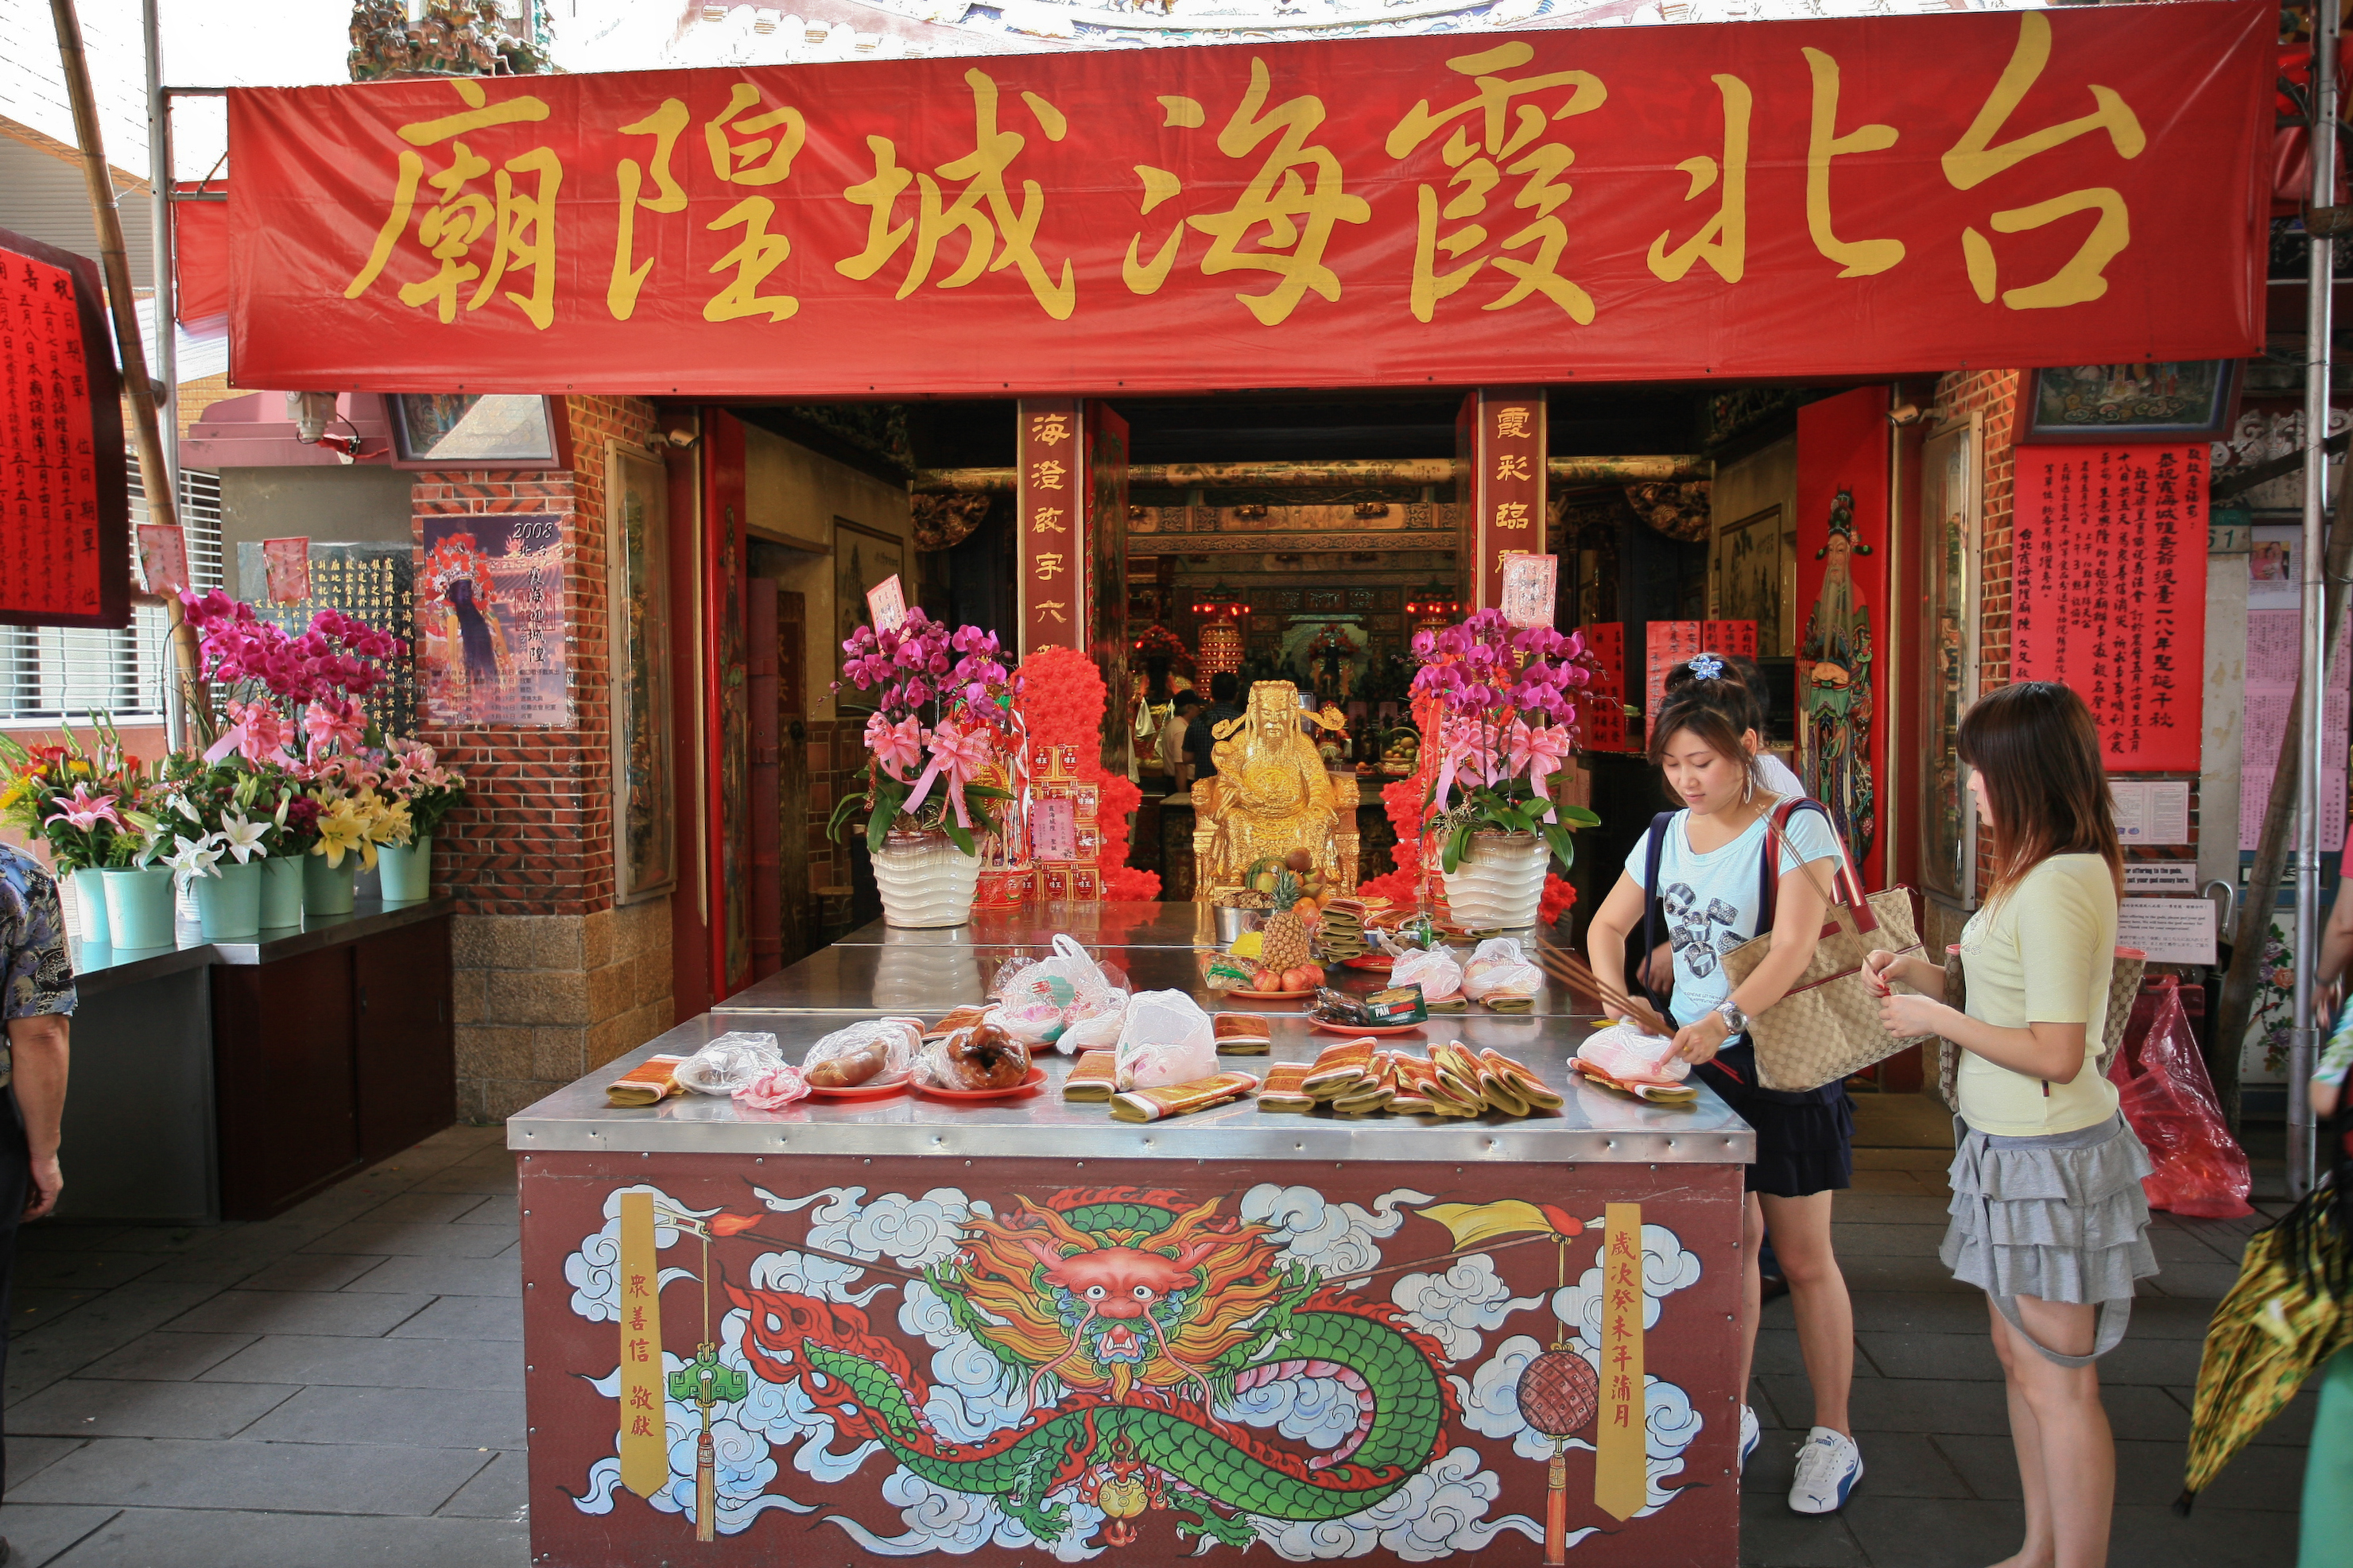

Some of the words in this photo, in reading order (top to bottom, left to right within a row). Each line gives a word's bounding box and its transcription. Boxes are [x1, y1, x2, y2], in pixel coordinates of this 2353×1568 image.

[345, 13, 2148, 332] 台北霞海城隍廟
[513, 521, 554, 539] 2008
[1031, 413, 1070, 655] 海澄啟宇六
[1374, 1005, 1390, 1017] PAN
[1610, 1230, 1637, 1429] 歲次癸未年蒲月
